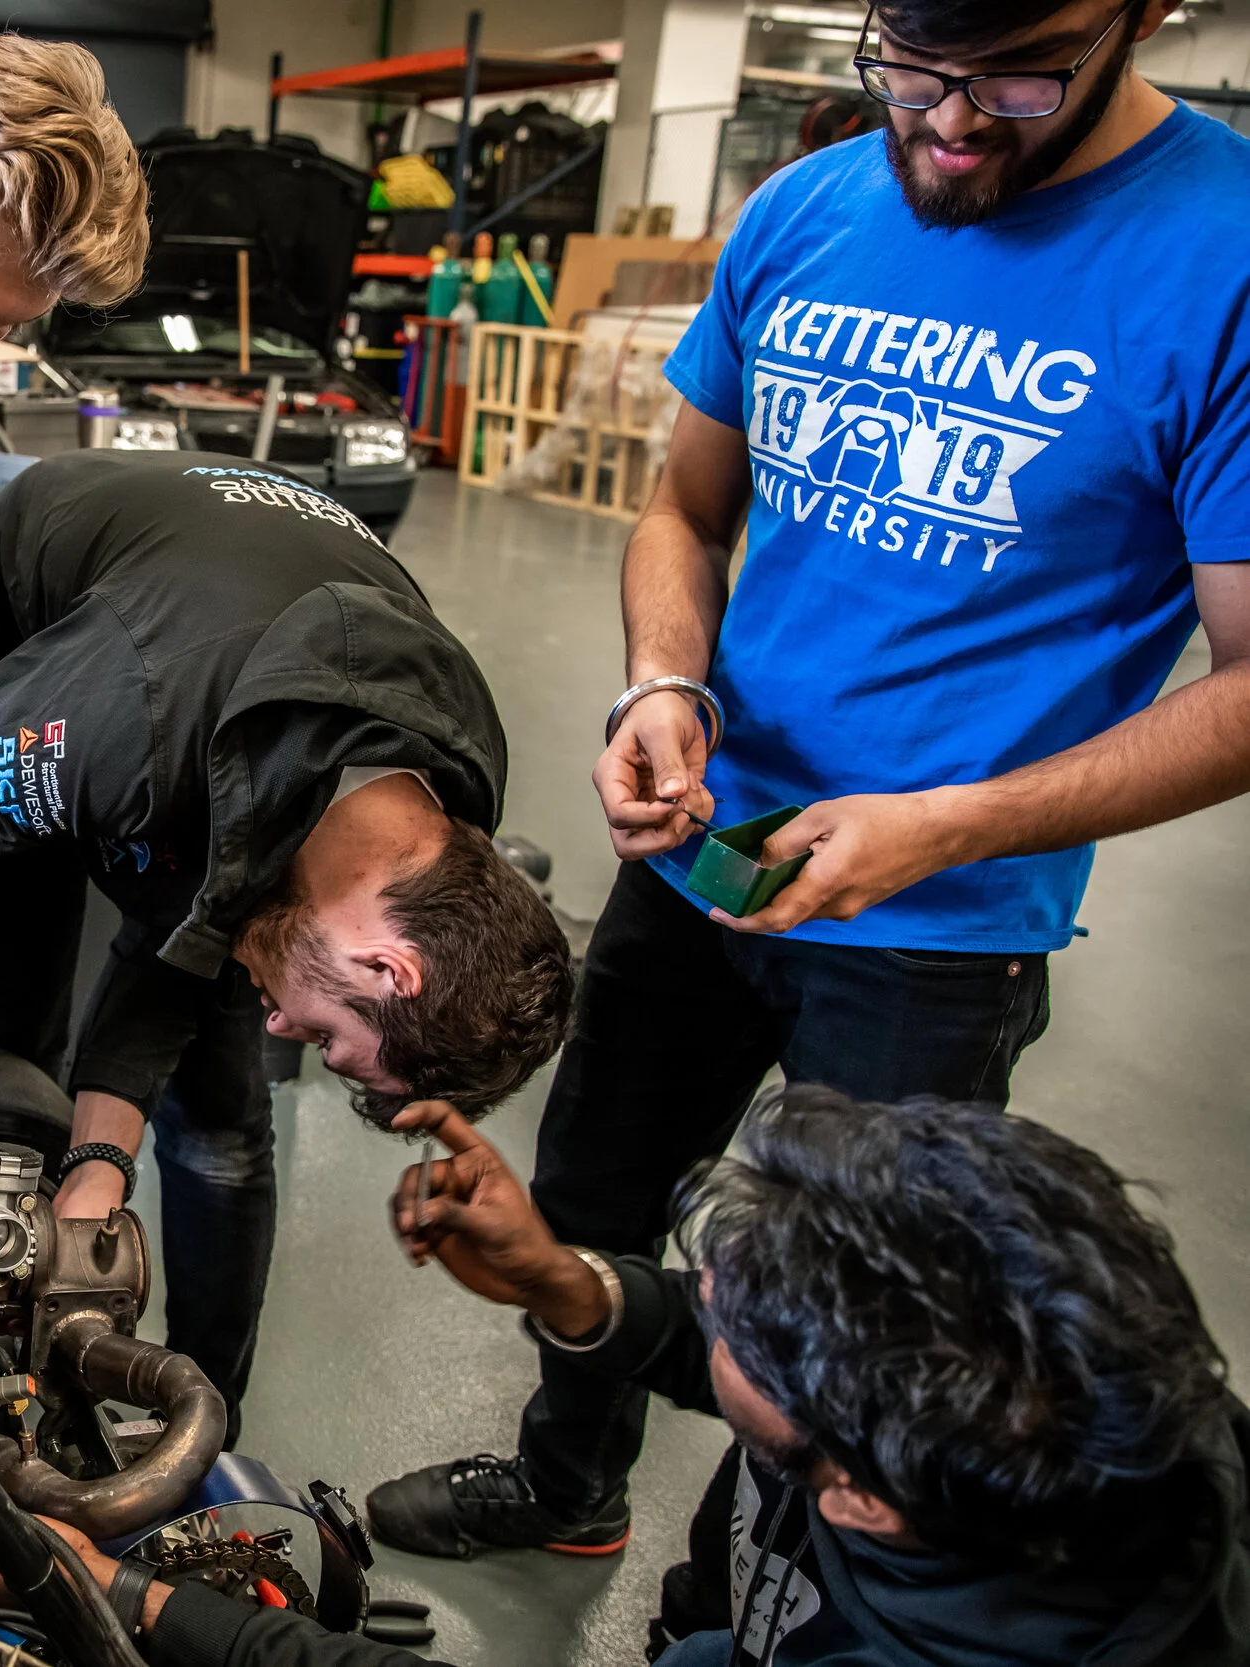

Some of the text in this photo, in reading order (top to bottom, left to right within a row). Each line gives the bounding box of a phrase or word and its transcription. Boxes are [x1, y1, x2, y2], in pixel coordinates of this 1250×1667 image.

[758, 295, 1097, 414] KETTERING
[760, 382, 1005, 506] 19 19
[41, 762, 55, 806] Structural
[49, 762, 66, 810] Continental
